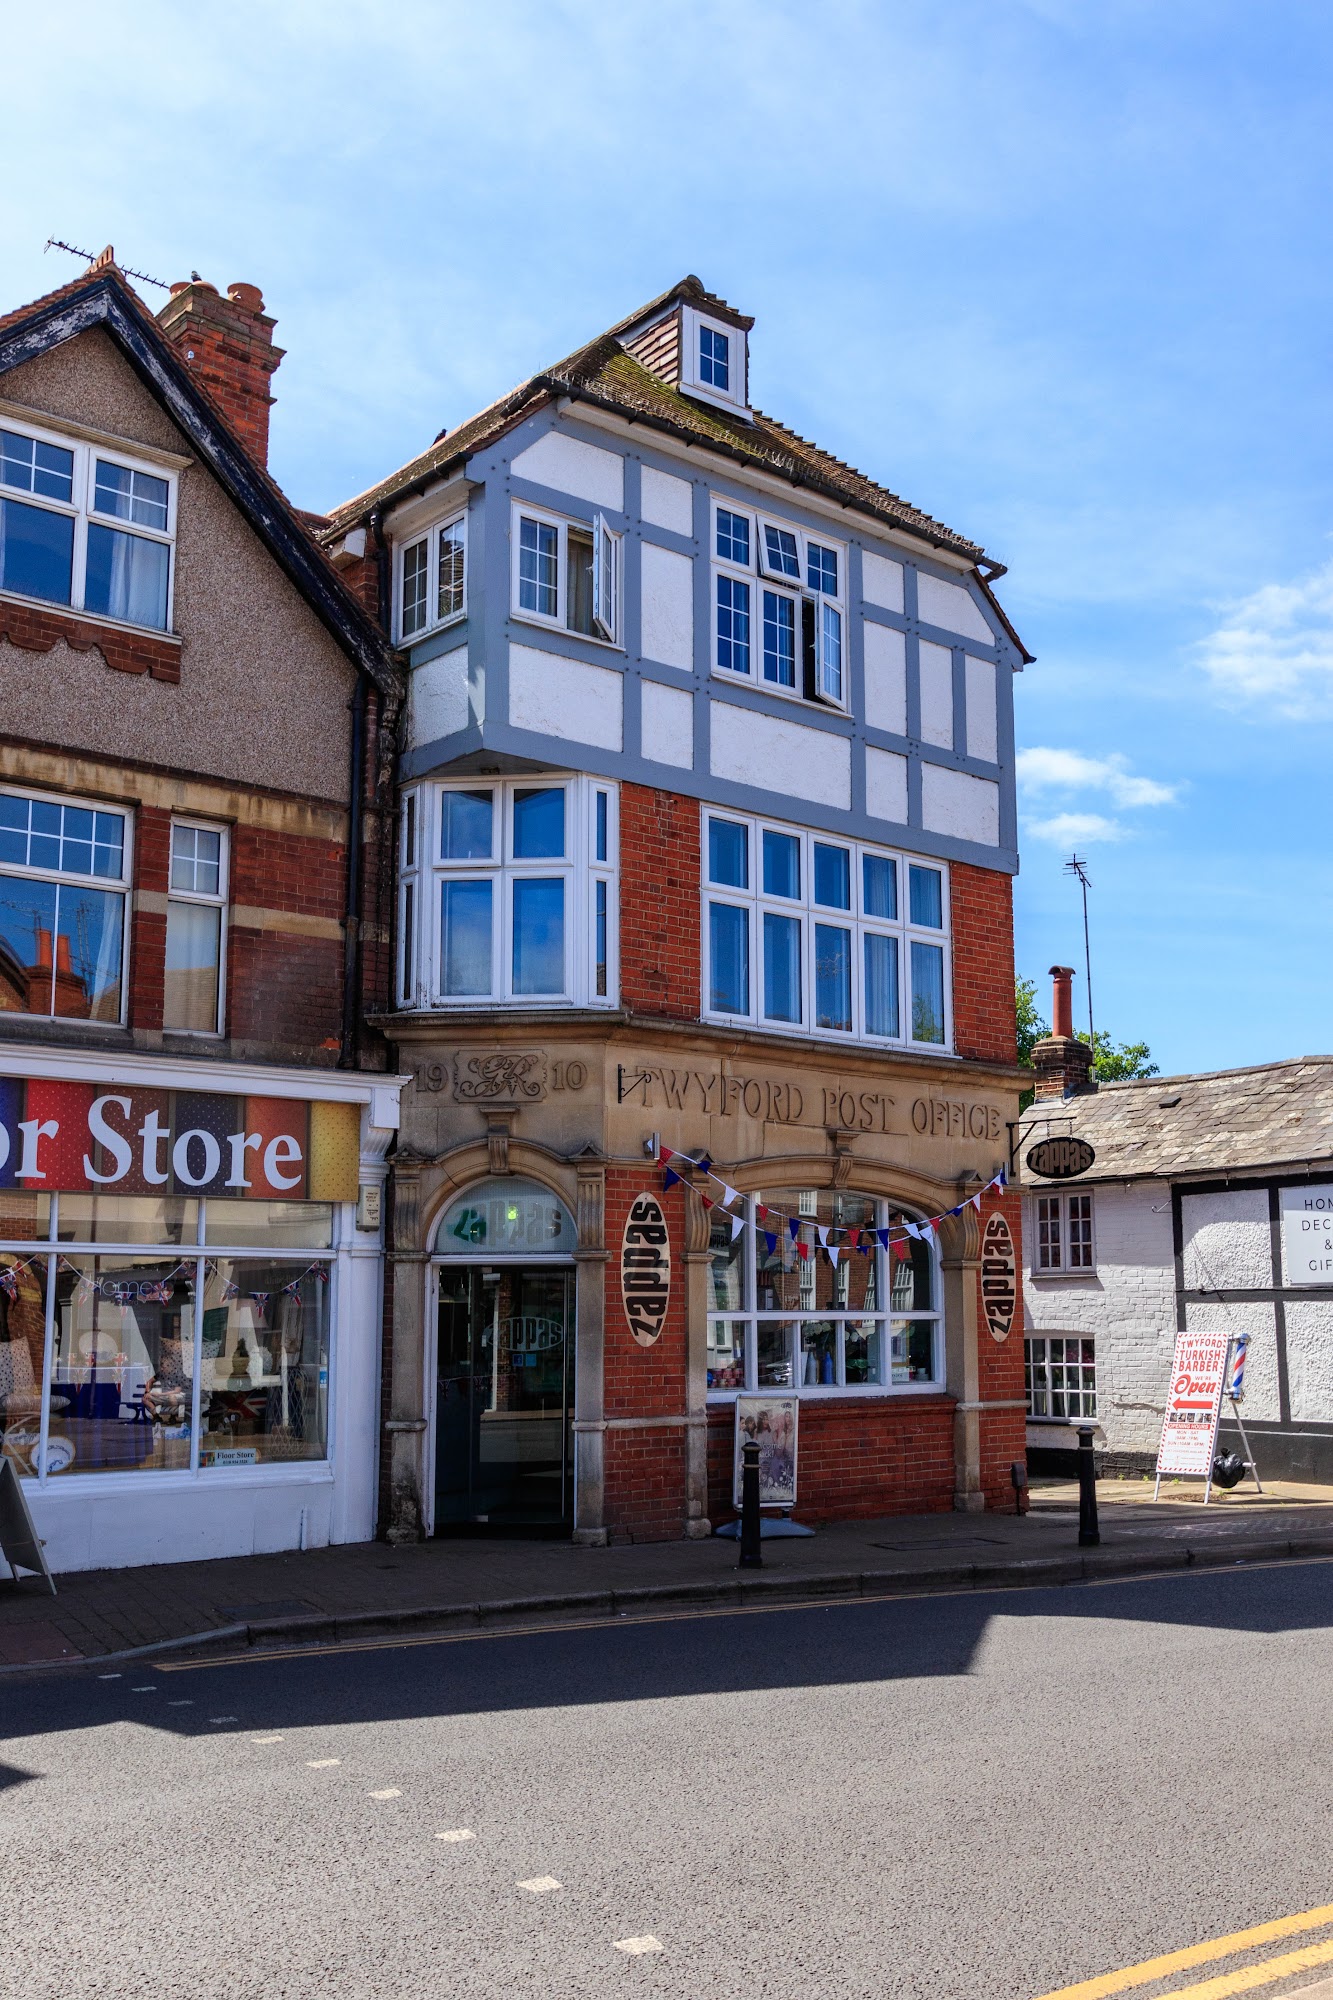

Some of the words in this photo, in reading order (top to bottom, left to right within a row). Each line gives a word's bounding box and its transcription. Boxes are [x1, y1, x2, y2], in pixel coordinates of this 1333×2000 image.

[415, 1063, 448, 1092] 19
[552, 1060, 588, 1090] 10
[636, 1066, 803, 1121] TWYFORD
[822, 1087, 895, 1132] POST
[911, 1098, 1000, 1141] OFFICE
[0, 1118, 60, 1180] r
[82, 1094, 303, 1190] Store
[1030, 1140, 1092, 1174] zappas
[453, 1200, 561, 1247] zappas
[1301, 1218, 1331, 1231] DEC
[1324, 1238, 1333, 1251] &
[623, 1201, 669, 1337] zappas
[982, 1220, 1014, 1334] zappas
[1308, 1259, 1333, 1271] GIF
[1179, 1350, 1221, 1360] TURKISH
[1181, 1338, 1222, 1349] TWYFORD
[1178, 1361, 1218, 1372] BARBER
[1174, 1374, 1217, 1396] Open
[237, 1451, 254, 1459] Store
